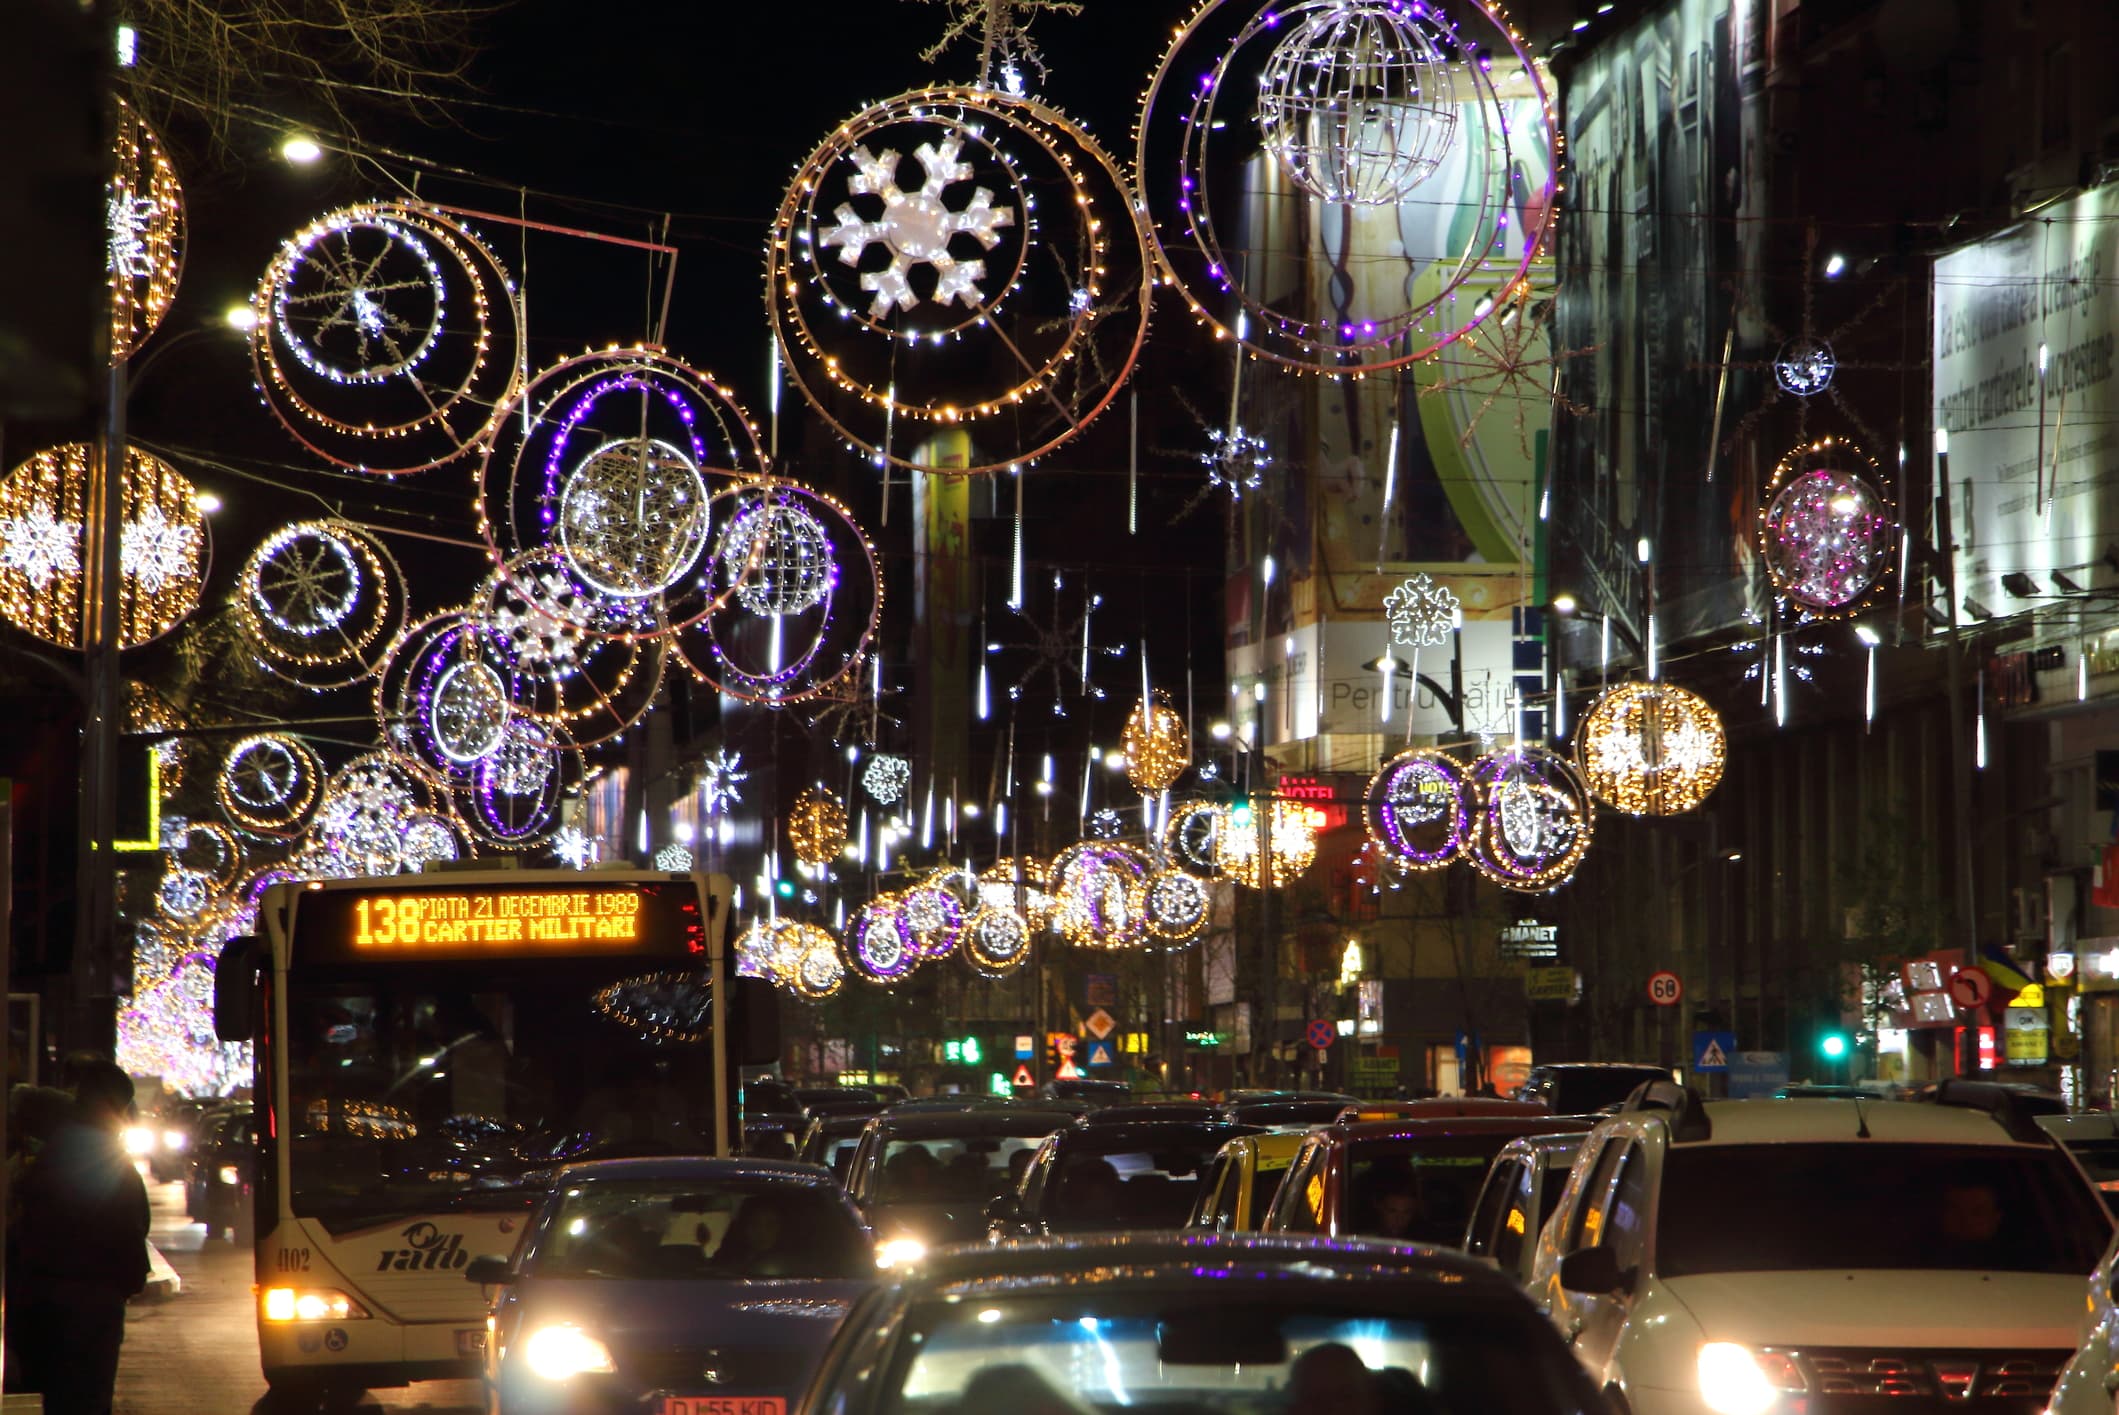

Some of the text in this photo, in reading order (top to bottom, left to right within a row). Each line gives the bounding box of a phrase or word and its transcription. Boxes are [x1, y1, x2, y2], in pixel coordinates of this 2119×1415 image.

[419, 893, 639, 920] PIATA 21 DECEMBRIE 1989
[356, 898, 420, 945] 138
[423, 915, 636, 943] CARTIER MILITARI
[1654, 978, 1677, 999] 60
[277, 1246, 311, 1273] 4102
